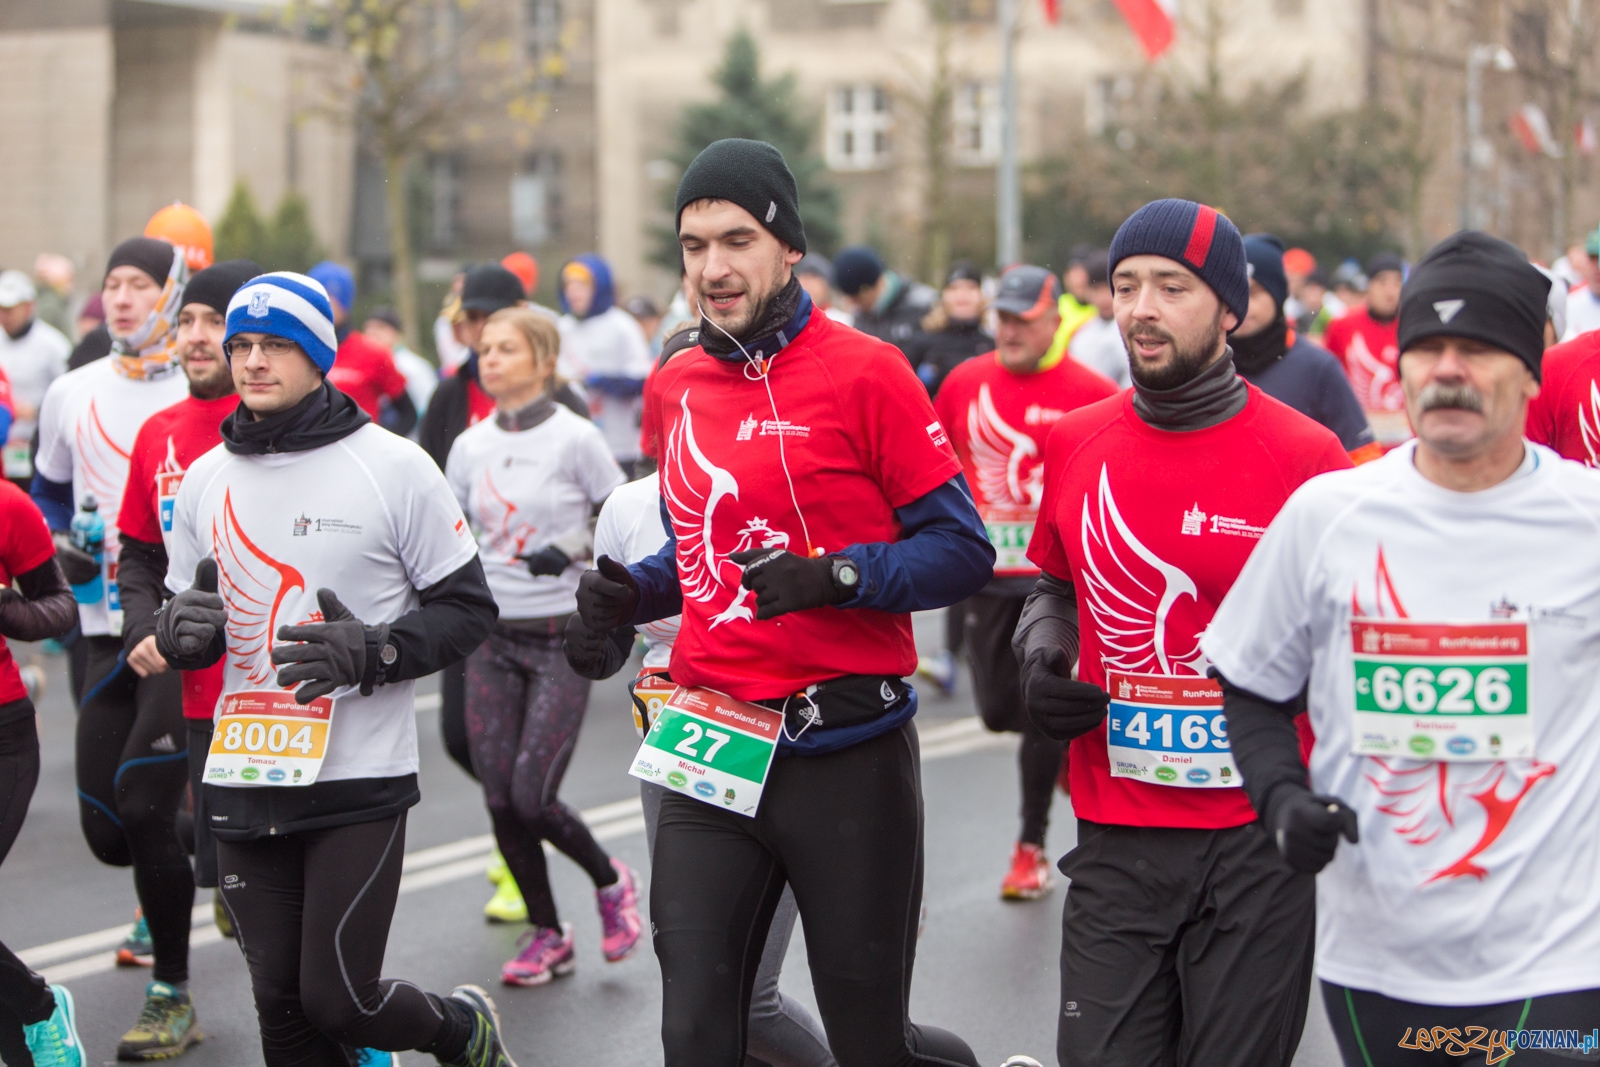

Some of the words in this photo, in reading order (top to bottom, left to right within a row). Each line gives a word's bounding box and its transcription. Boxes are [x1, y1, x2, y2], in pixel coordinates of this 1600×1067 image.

[315, 518, 322, 532] 1
[1210, 514, 1220, 533] 1
[1356, 676, 1370, 695] C
[1372, 666, 1512, 714] 6626
[272, 702, 324, 714] RunPoland.org
[715, 706, 771, 731] RunPoland.org
[1112, 718, 1121, 731] E
[1124, 712, 1231, 750] 4169
[215, 732, 222, 740] D
[224, 722, 312, 754] 8004
[653, 722, 662, 732] C
[674, 722, 731, 763] 27
[248, 757, 276, 765] Tomasz
[638, 760, 653, 770] GRUPA
[1116, 761, 1138, 770] GRUPA
[1162, 755, 1192, 764] Daniel
[634, 766, 654, 776] LUXMED
[1117, 768, 1142, 776] LUXMED
